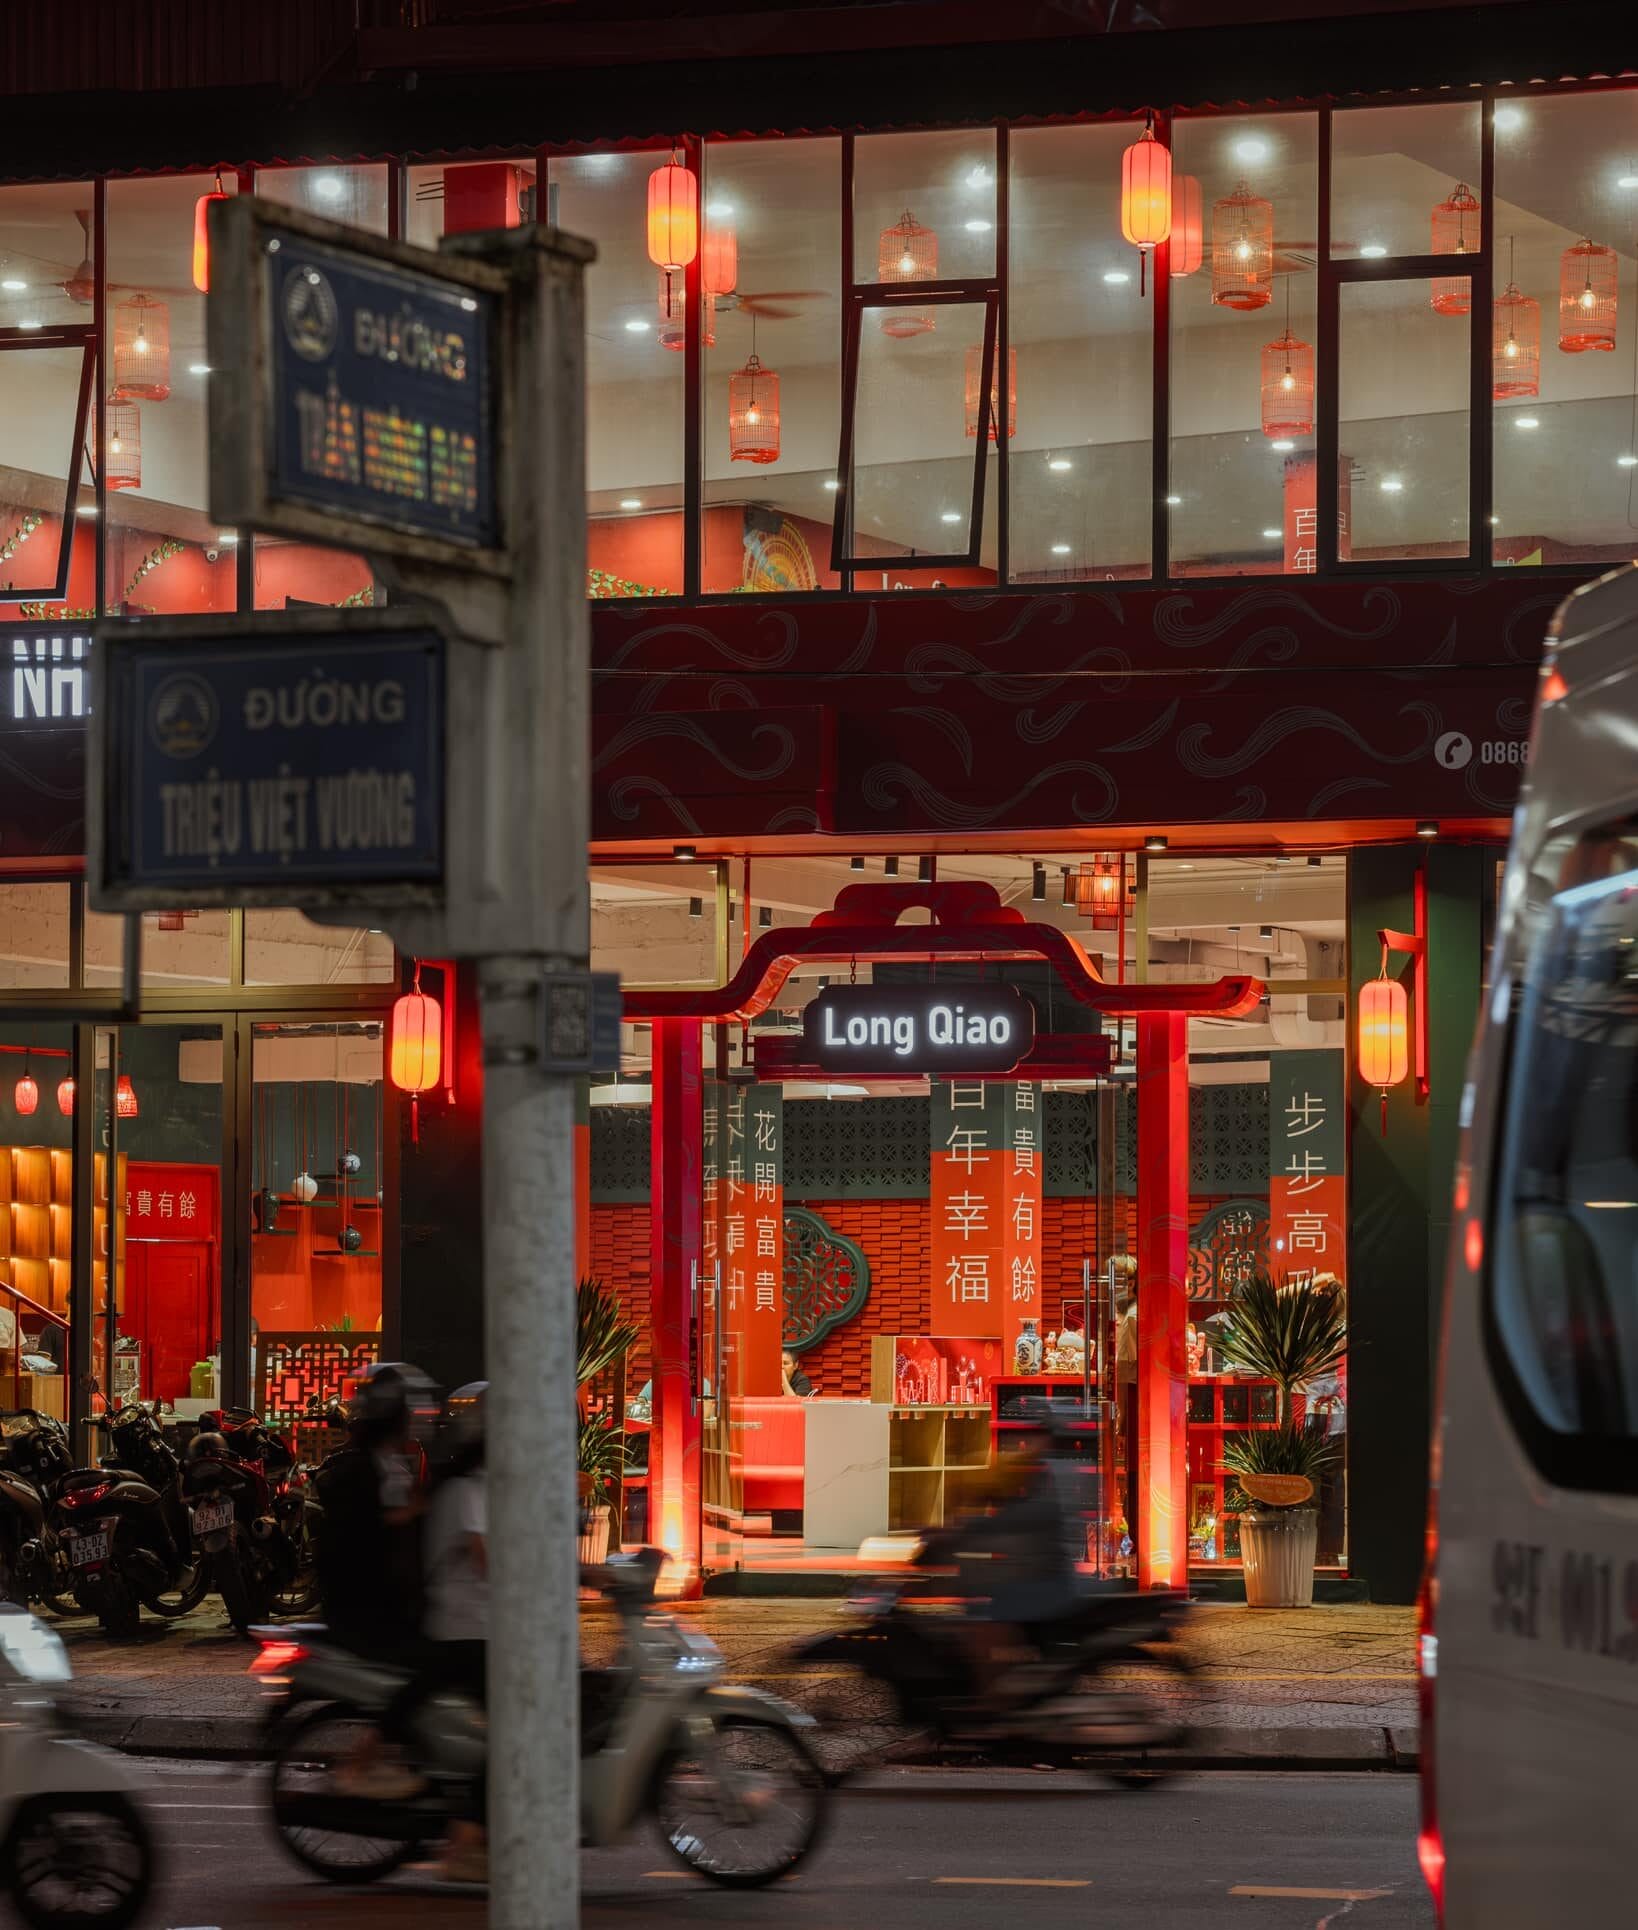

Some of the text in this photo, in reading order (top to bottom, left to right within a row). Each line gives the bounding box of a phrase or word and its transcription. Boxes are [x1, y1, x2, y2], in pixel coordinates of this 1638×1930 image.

[243, 667, 406, 731] ĐƯỜNG
[160, 766, 242, 867] TRIỆU
[248, 763, 310, 865] VIỆT
[825, 1005, 1010, 1055] Long Qiao
[753, 1109, 777, 1312] 花開富貴
